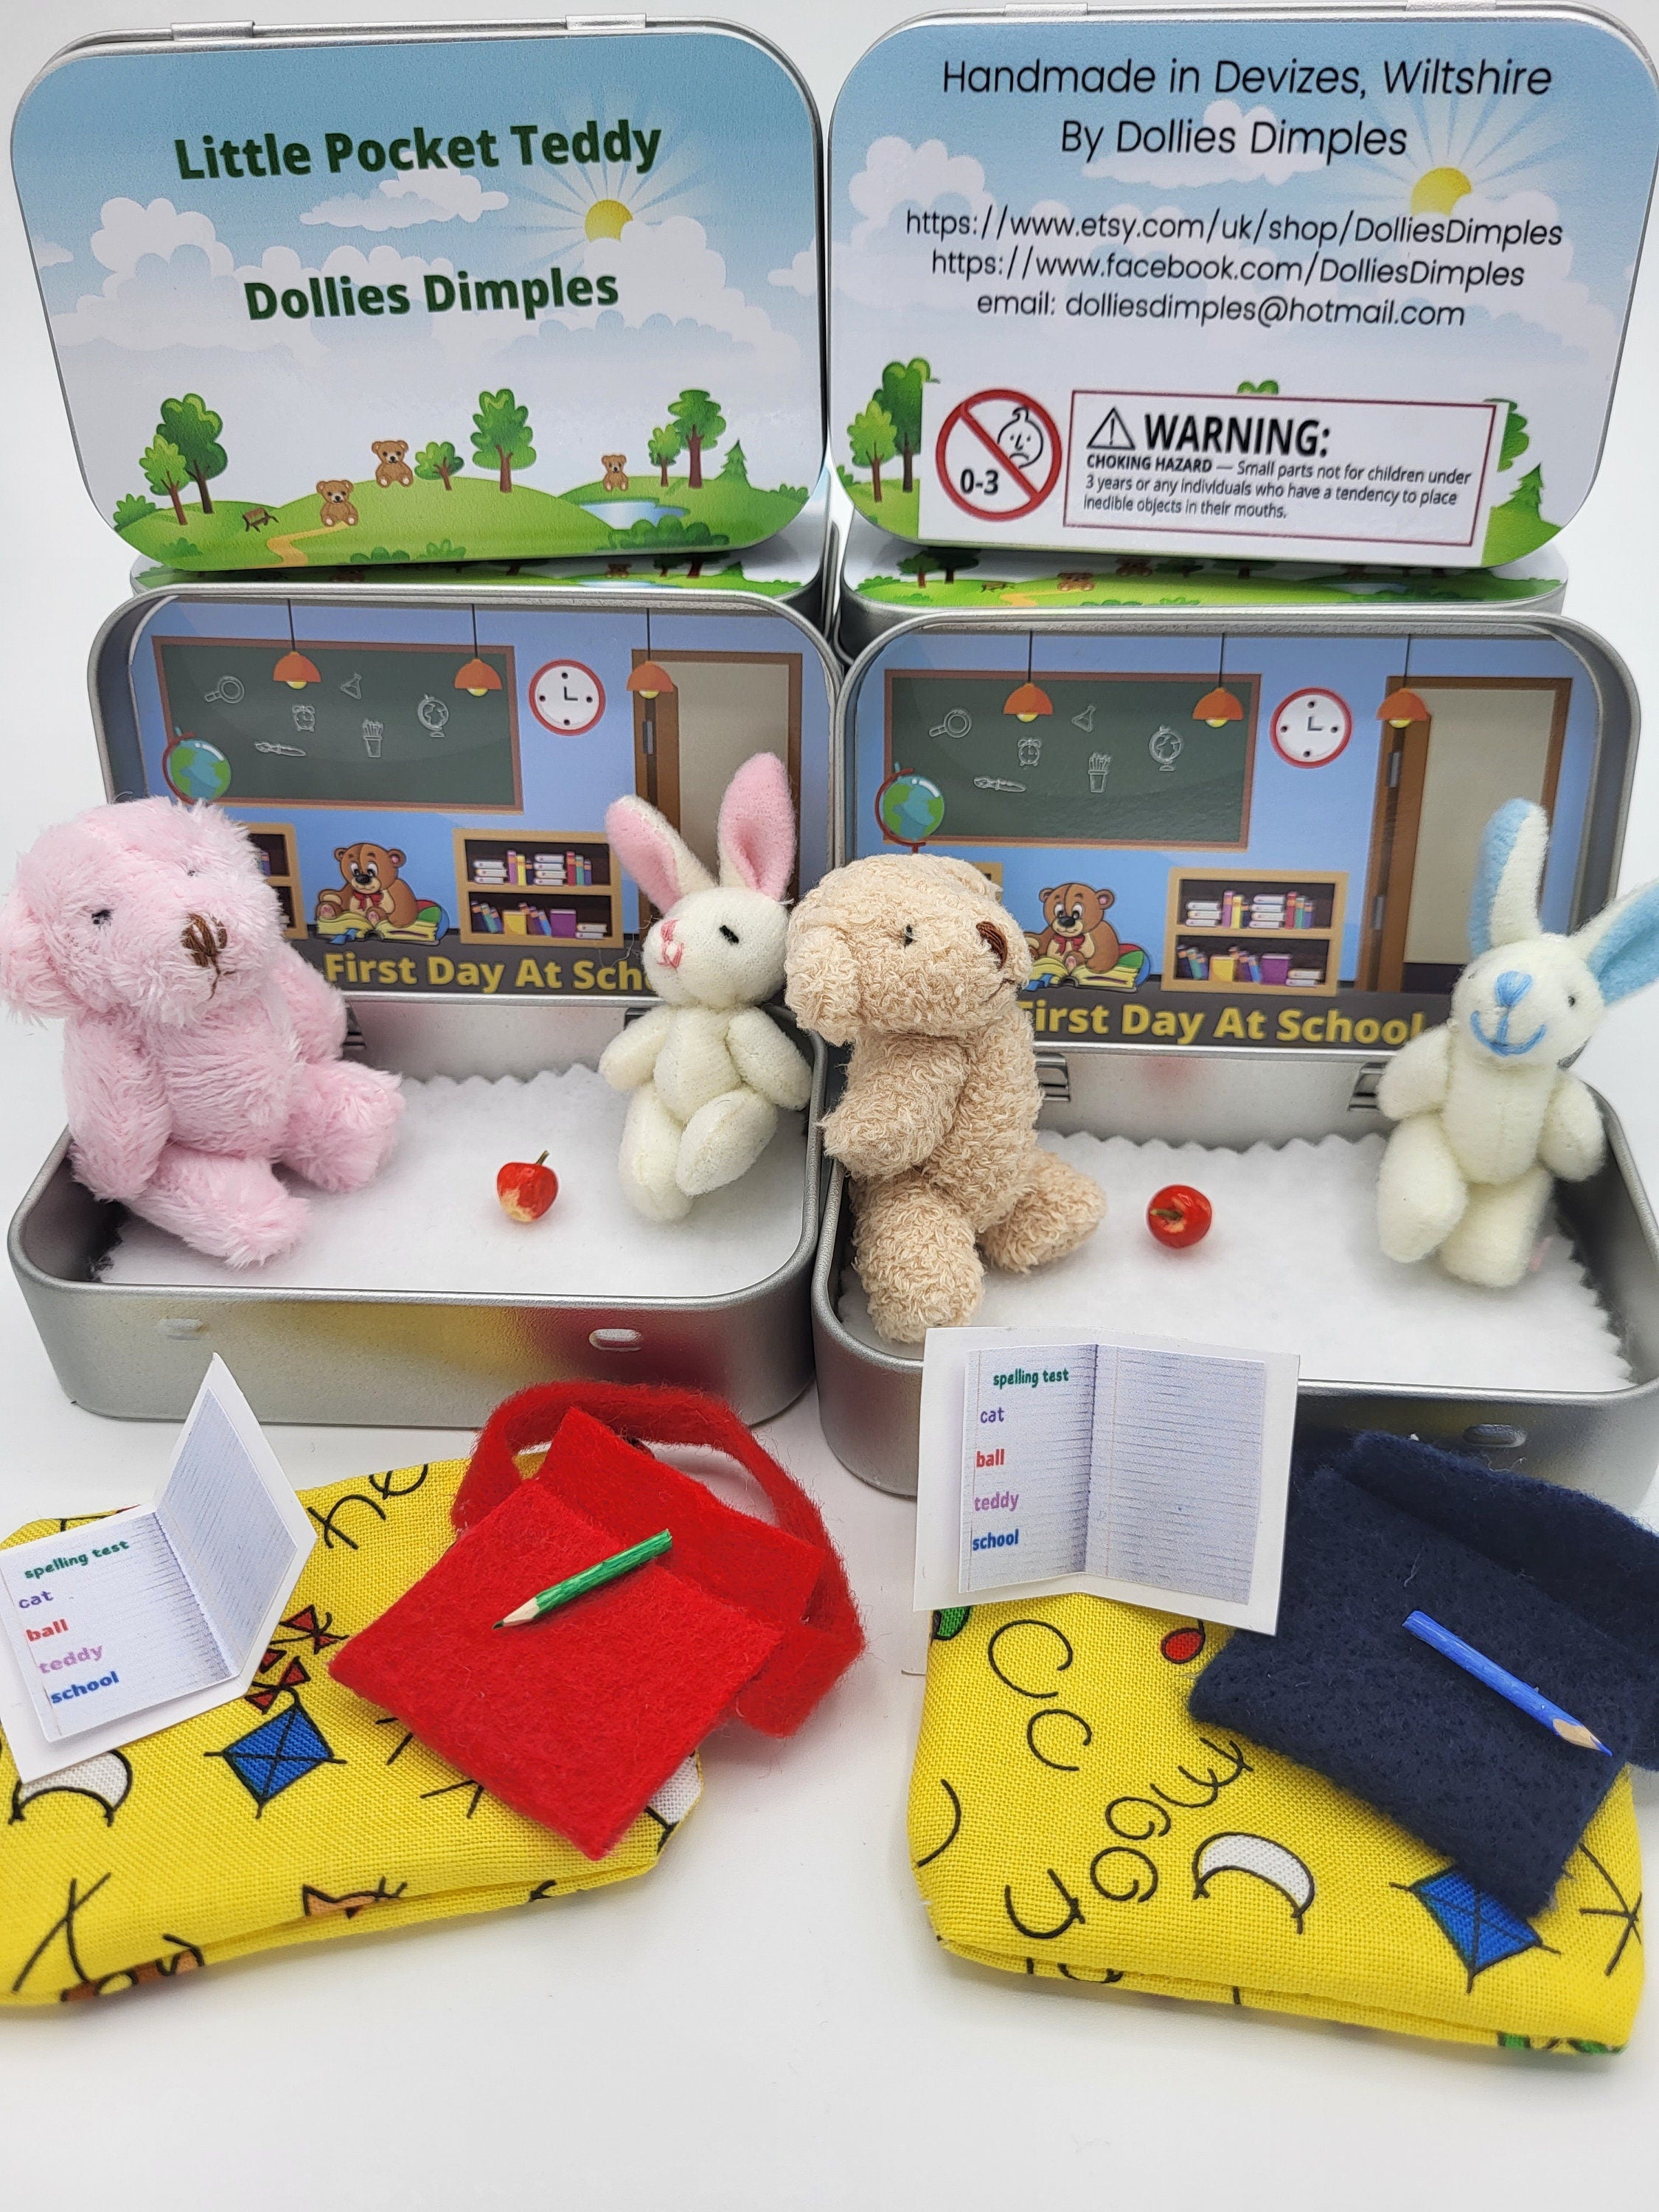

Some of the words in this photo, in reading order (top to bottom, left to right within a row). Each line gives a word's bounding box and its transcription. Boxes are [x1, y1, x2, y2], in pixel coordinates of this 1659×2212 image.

[944, 60, 1156, 94] Handmade
[1170, 60, 1200, 94] in
[1216, 60, 1368, 99] Devizes,
[1385, 58, 1552, 96] Wiltshire
[174, 133, 311, 180] Little
[324, 127, 499, 173] Pocket
[509, 119, 661, 173] Teddy
[1062, 120, 1105, 163] By
[1116, 118, 1237, 155] Dollies
[1251, 120, 1408, 165] Dimples
[906, 206, 1563, 250] https://www.etsy.com/uk/shop/DolliesDimples
[931, 246, 1525, 291] https://www.facebook.com/DolliesDimples
[244, 276, 410, 321] Dollies
[422, 268, 619, 320] Dimples
[977, 293, 1057, 318] email:
[1066, 295, 1466, 328] dolliesdimples@hotmail.com
[1144, 413, 1330, 457] WARNING:
[959, 468, 999, 495] 0-3
[1087, 455, 1151, 470] CHOKING
[1155, 456, 1211, 473] HAZARD
[1237, 460, 1273, 475] Small
[1278, 462, 1313, 478] parts
[1317, 465, 1340, 479] not
[1345, 464, 1364, 480] for
[1368, 465, 1425, 483] children
[1427, 469, 1472, 485] under
[1084, 494, 1133, 511] inedible
[1137, 497, 1181, 515] objects
[1186, 500, 1197, 513] in
[1200, 500, 1230, 515] their
[1234, 502, 1287, 518] mouths.
[1086, 475, 1094, 488] 3
[1097, 476, 1132, 493] years
[1135, 478, 1151, 491] or
[1153, 479, 1177, 495] any
[1180, 479, 1251, 496] individuals
[1255, 482, 1284, 497] who
[1288, 483, 1320, 498] have
[1324, 487, 1332, 498] a
[1336, 486, 1399, 506] tendency
[1402, 490, 1416, 504] to
[1419, 490, 1458, 509] place
[325, 952, 417, 984] First
[428, 956, 505, 993] Day
[516, 959, 563, 989] At
[1121, 1004, 1204, 1045] Day
[1214, 1007, 1267, 1040] At
[1276, 1009, 1425, 1046] School
[992, 1369, 1039, 1389] spelling
[1043, 1368, 1069, 1382] test
[980, 1407, 1005, 1423] cat
[976, 1449, 1005, 1467] ball
[974, 1492, 1019, 1512] teddy
[972, 1529, 1019, 1551] school
[24, 1553, 88, 1579] spelling
[91, 1540, 129, 1558] test
[18, 1590, 55, 1609] cat
[26, 1619, 69, 1642] ball
[38, 1644, 104, 1674] teddy
[51, 1672, 119, 1704] school
